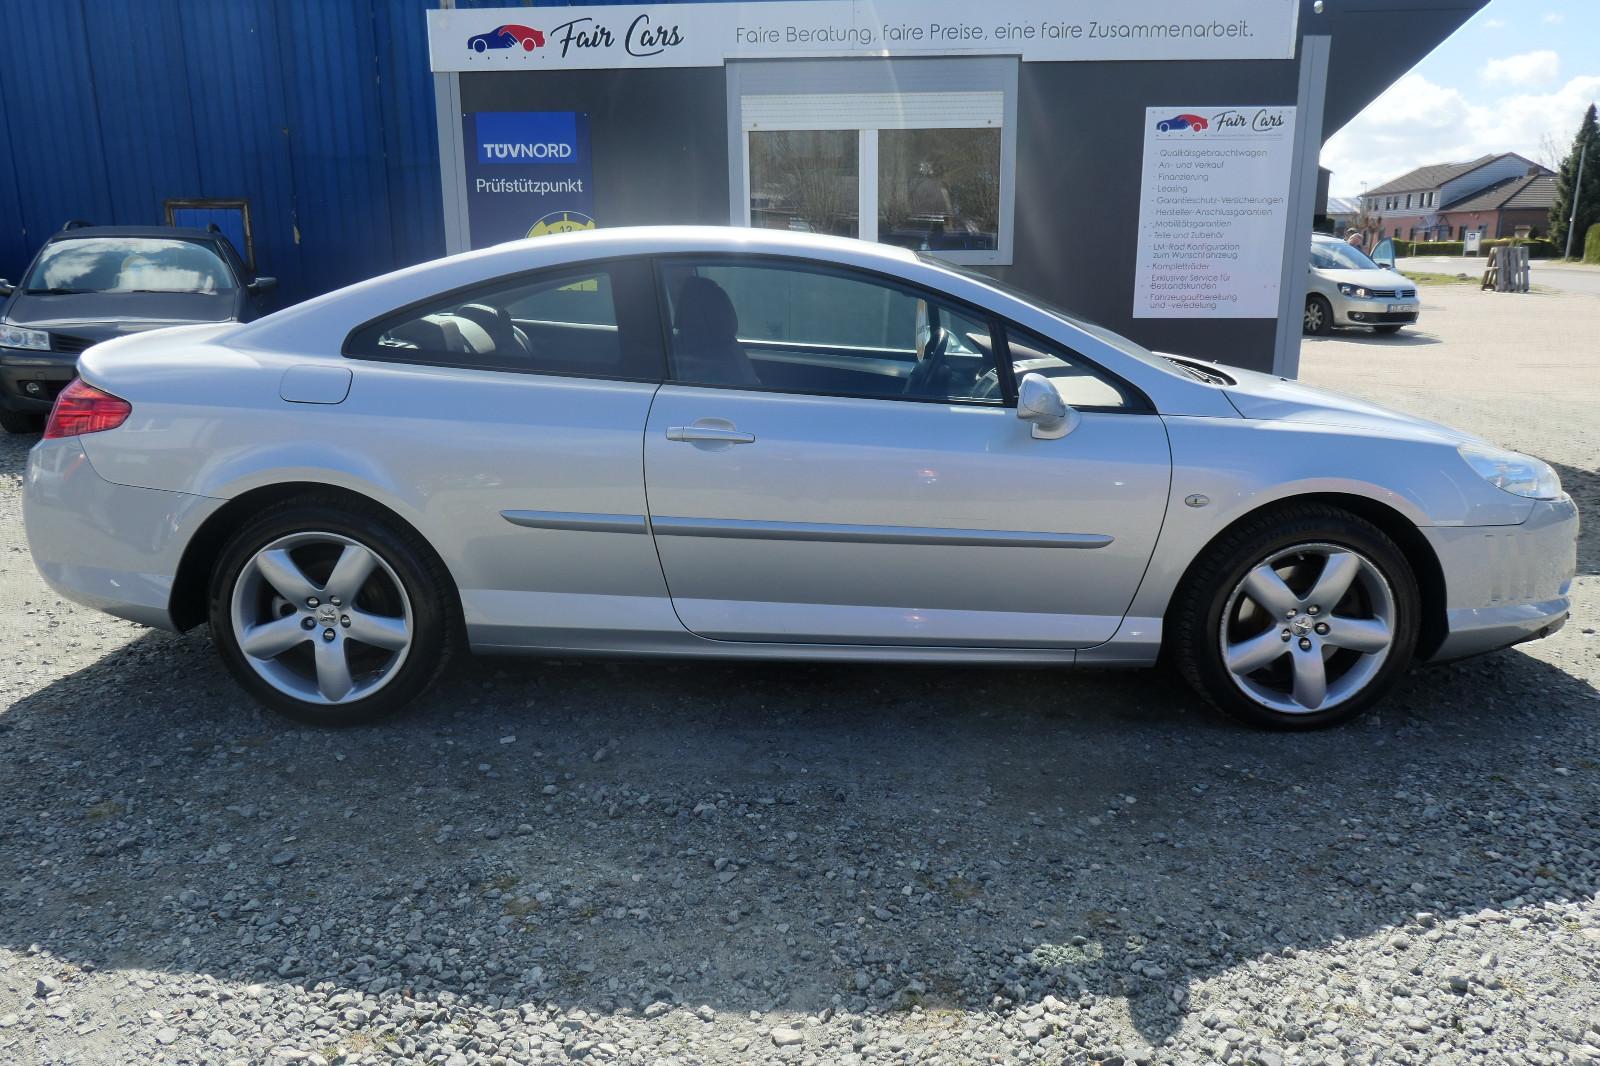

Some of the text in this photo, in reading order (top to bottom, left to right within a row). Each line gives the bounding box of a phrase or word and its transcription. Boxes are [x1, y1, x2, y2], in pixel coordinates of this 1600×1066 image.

[550, 14, 685, 58] Fair Cars
[736, 20, 1254, 45] Faire Beratung, faire Preise, eine faire Zusammenarbeit.
[1212, 109, 1284, 133] Fair Cars
[1175, 161, 1193, 169] und
[1194, 161, 1225, 169] Verkauf
[1158, 173, 1209, 182] Finanzierung
[476, 178, 584, 196] Prüfstützpunkt
[1157, 185, 1188, 194] Leasing
[1154, 220, 1232, 229] Mobilitätsgarantien
[1153, 231, 1225, 239] Teile und Zubehör
[1186, 243, 1240, 252] Konfiguration
[1171, 251, 1238, 260] Wunschfahrzeug
[1152, 262, 1210, 272] Kompletträder
[1151, 274, 1231, 282] Exklusiver Service für
[1151, 282, 1217, 290] Bestandskunden
[1150, 293, 1238, 302] Fahrzeugaufbereitung
